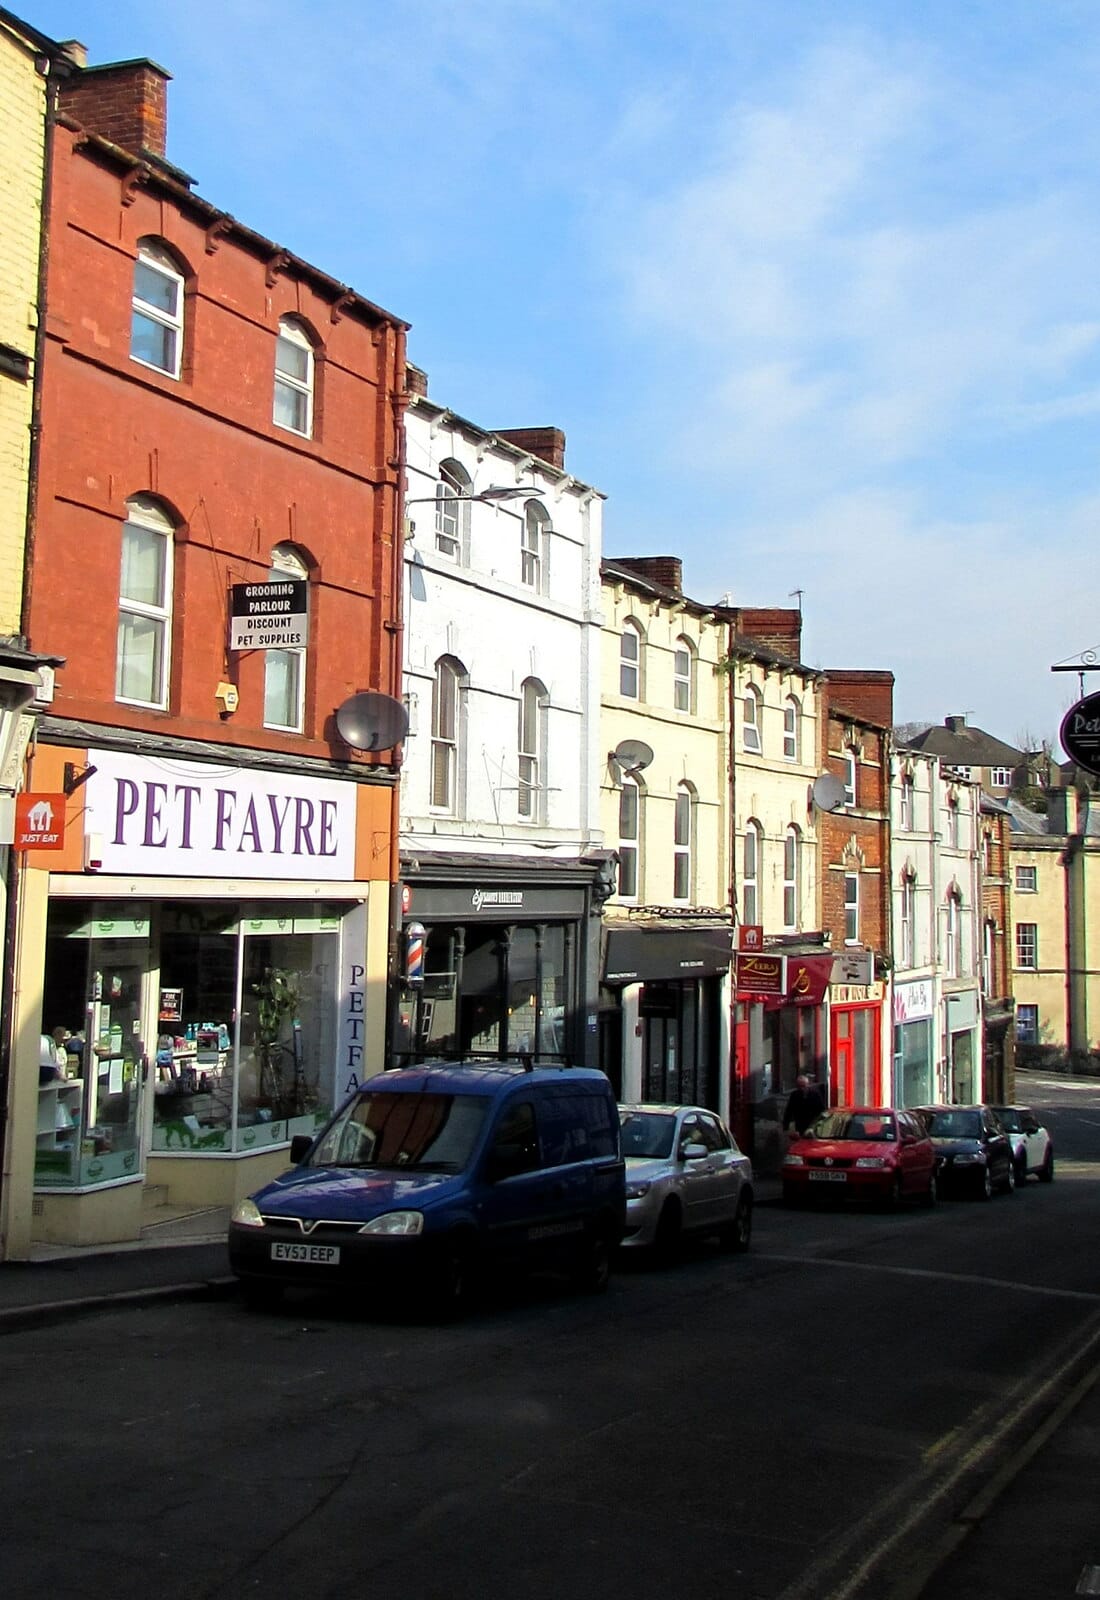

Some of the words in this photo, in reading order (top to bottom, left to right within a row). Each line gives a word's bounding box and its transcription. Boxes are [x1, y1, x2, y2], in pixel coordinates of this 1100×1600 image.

[245, 584, 294, 597] GROOMING
[249, 600, 291, 613] PARLOUR
[247, 617, 292, 629] DISCOUNT
[237, 635, 253, 646] PET
[259, 633, 301, 645] SUPPLIES
[110, 777, 201, 849] PET
[211, 788, 339, 857] FAYRE
[20, 834, 41, 843] JUST
[42, 834, 59, 843] EAT
[276, 1244, 307, 1260] EY53
[310, 1247, 335, 1262] EEP
